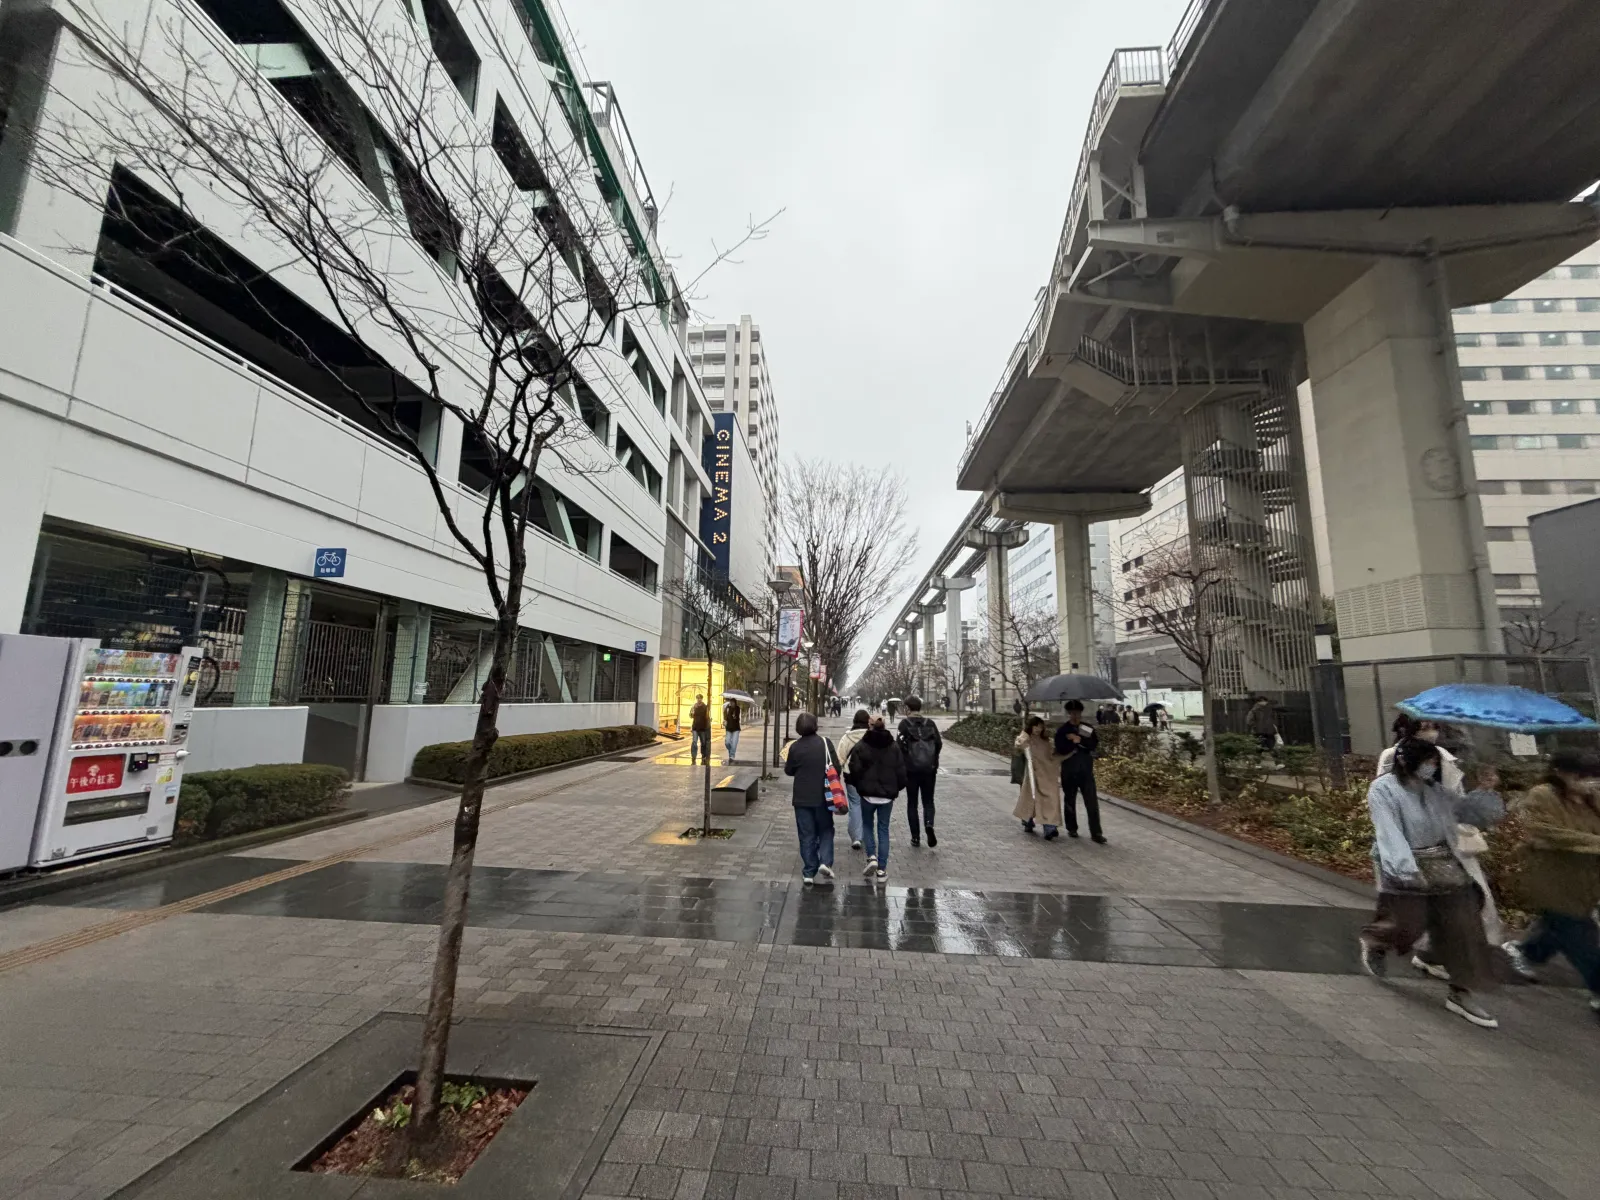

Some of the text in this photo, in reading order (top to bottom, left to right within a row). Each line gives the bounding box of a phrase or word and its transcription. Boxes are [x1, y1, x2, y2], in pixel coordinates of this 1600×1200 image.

[712, 429, 731, 544] CINEMA 2
[70, 773, 116, 788] 午後の紅茶
